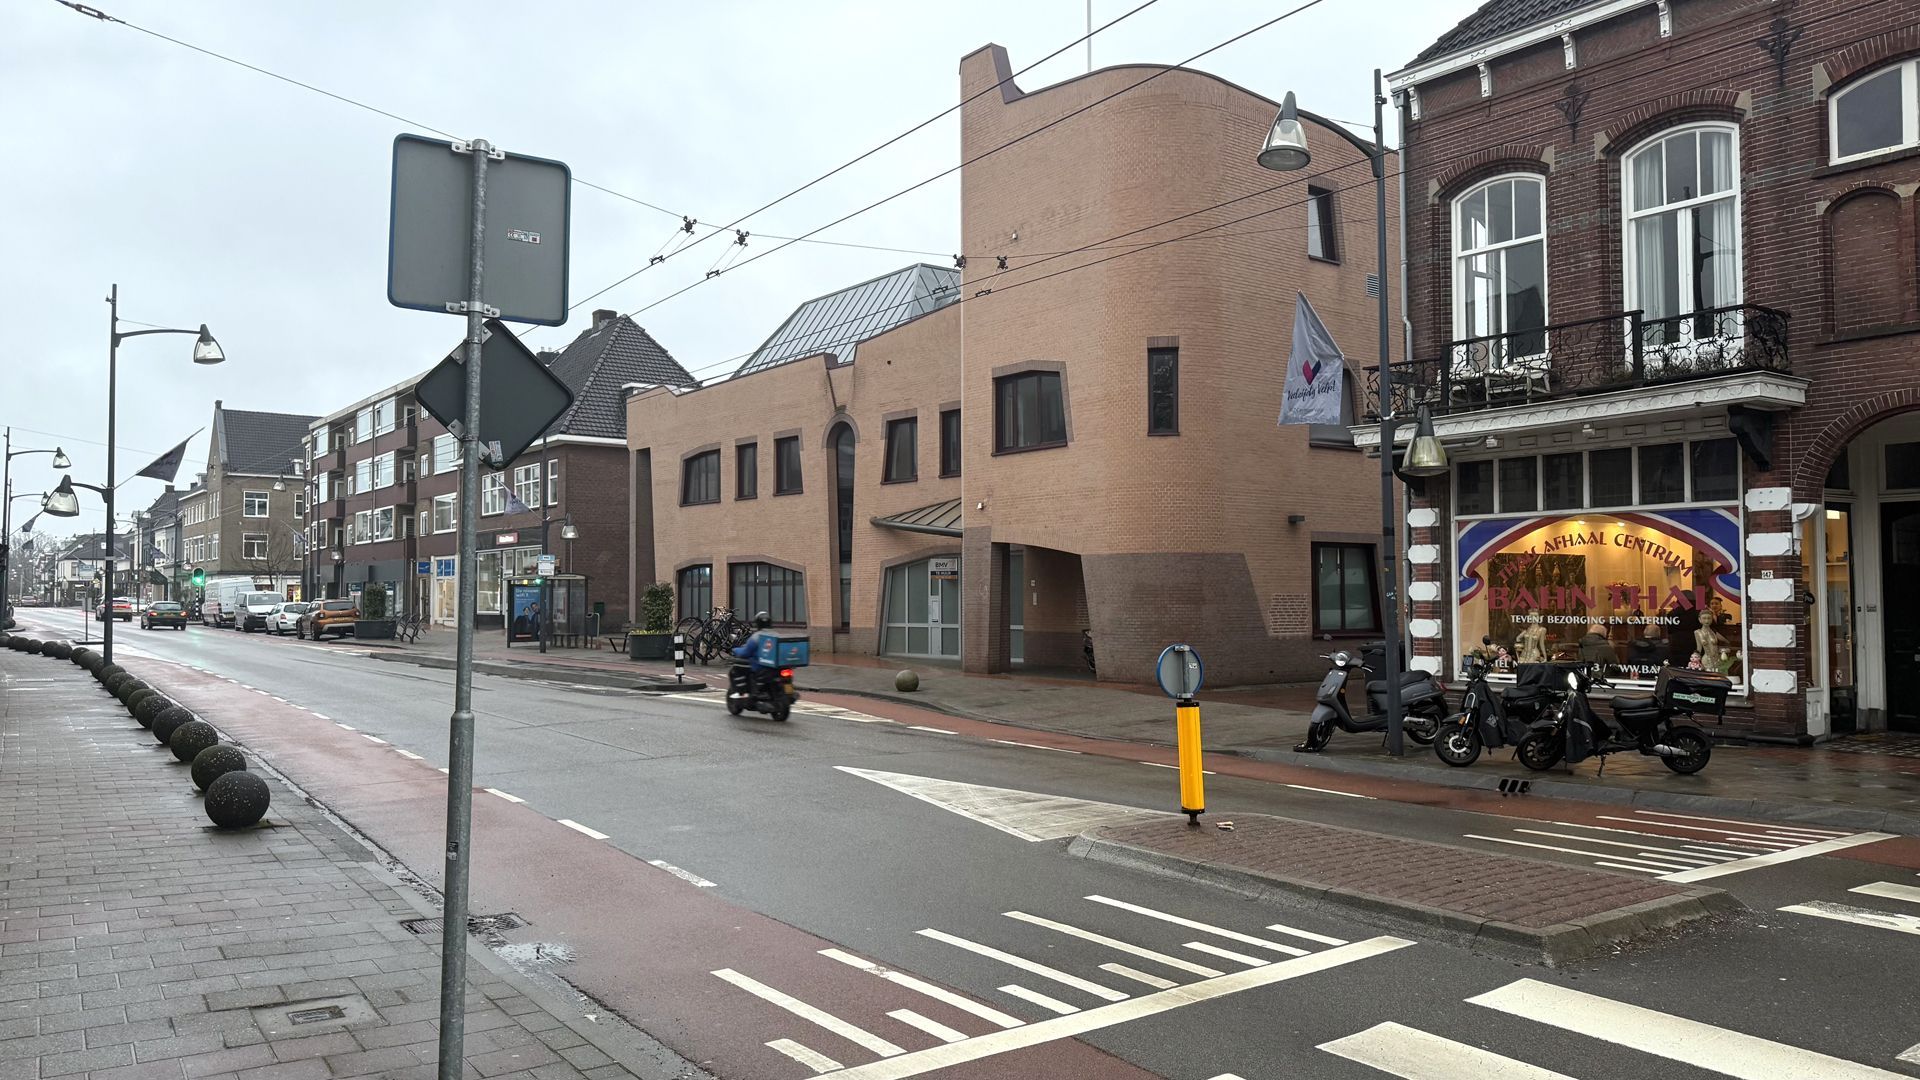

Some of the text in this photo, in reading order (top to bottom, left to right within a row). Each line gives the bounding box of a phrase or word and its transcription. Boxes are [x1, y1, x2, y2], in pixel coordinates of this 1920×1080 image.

[1544, 531, 1607, 554] AFHAAL
[1614, 533, 1693, 577] CENTRUM
[1487, 585, 1705, 610] BAHN THAI
[1510, 614, 1680, 625] TEVENS BEZORGING EN CATERING
